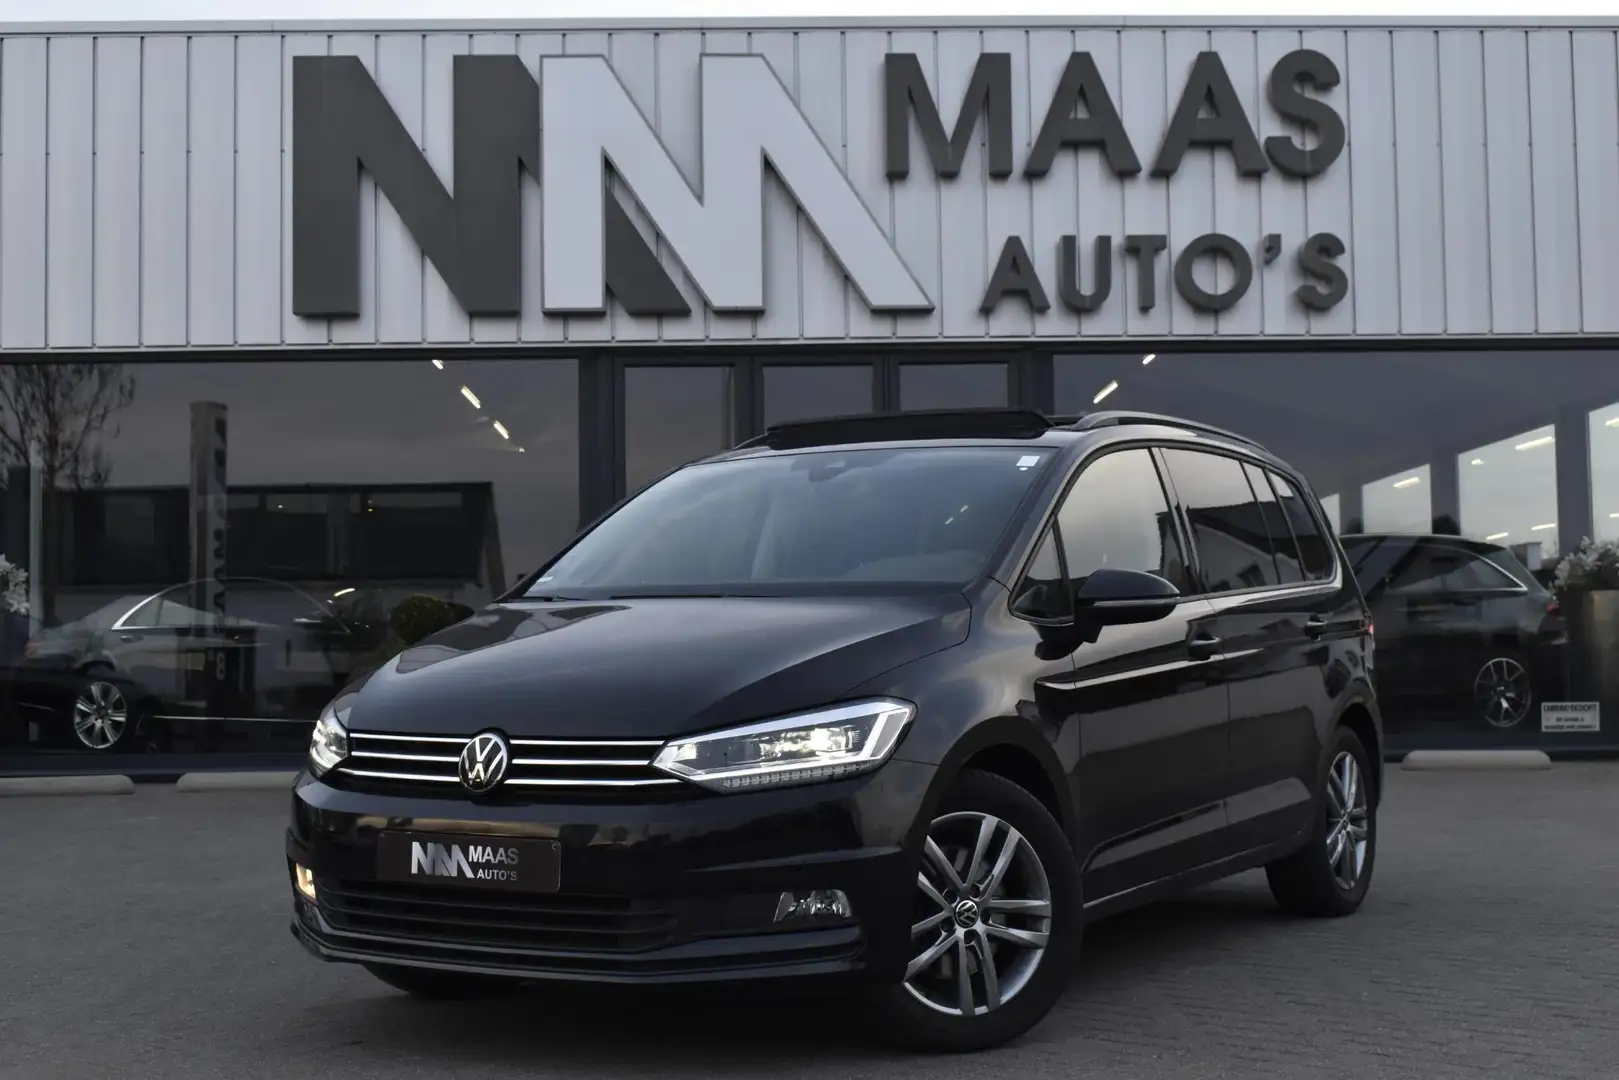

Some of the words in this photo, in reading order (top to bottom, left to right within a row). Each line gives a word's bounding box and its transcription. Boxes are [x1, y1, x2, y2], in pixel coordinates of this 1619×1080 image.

[885, 49, 1346, 180] MAAS
[978, 232, 1348, 314] AUTO'S
[469, 846, 519, 865] MAAS
[477, 868, 517, 882] AUTO'S
